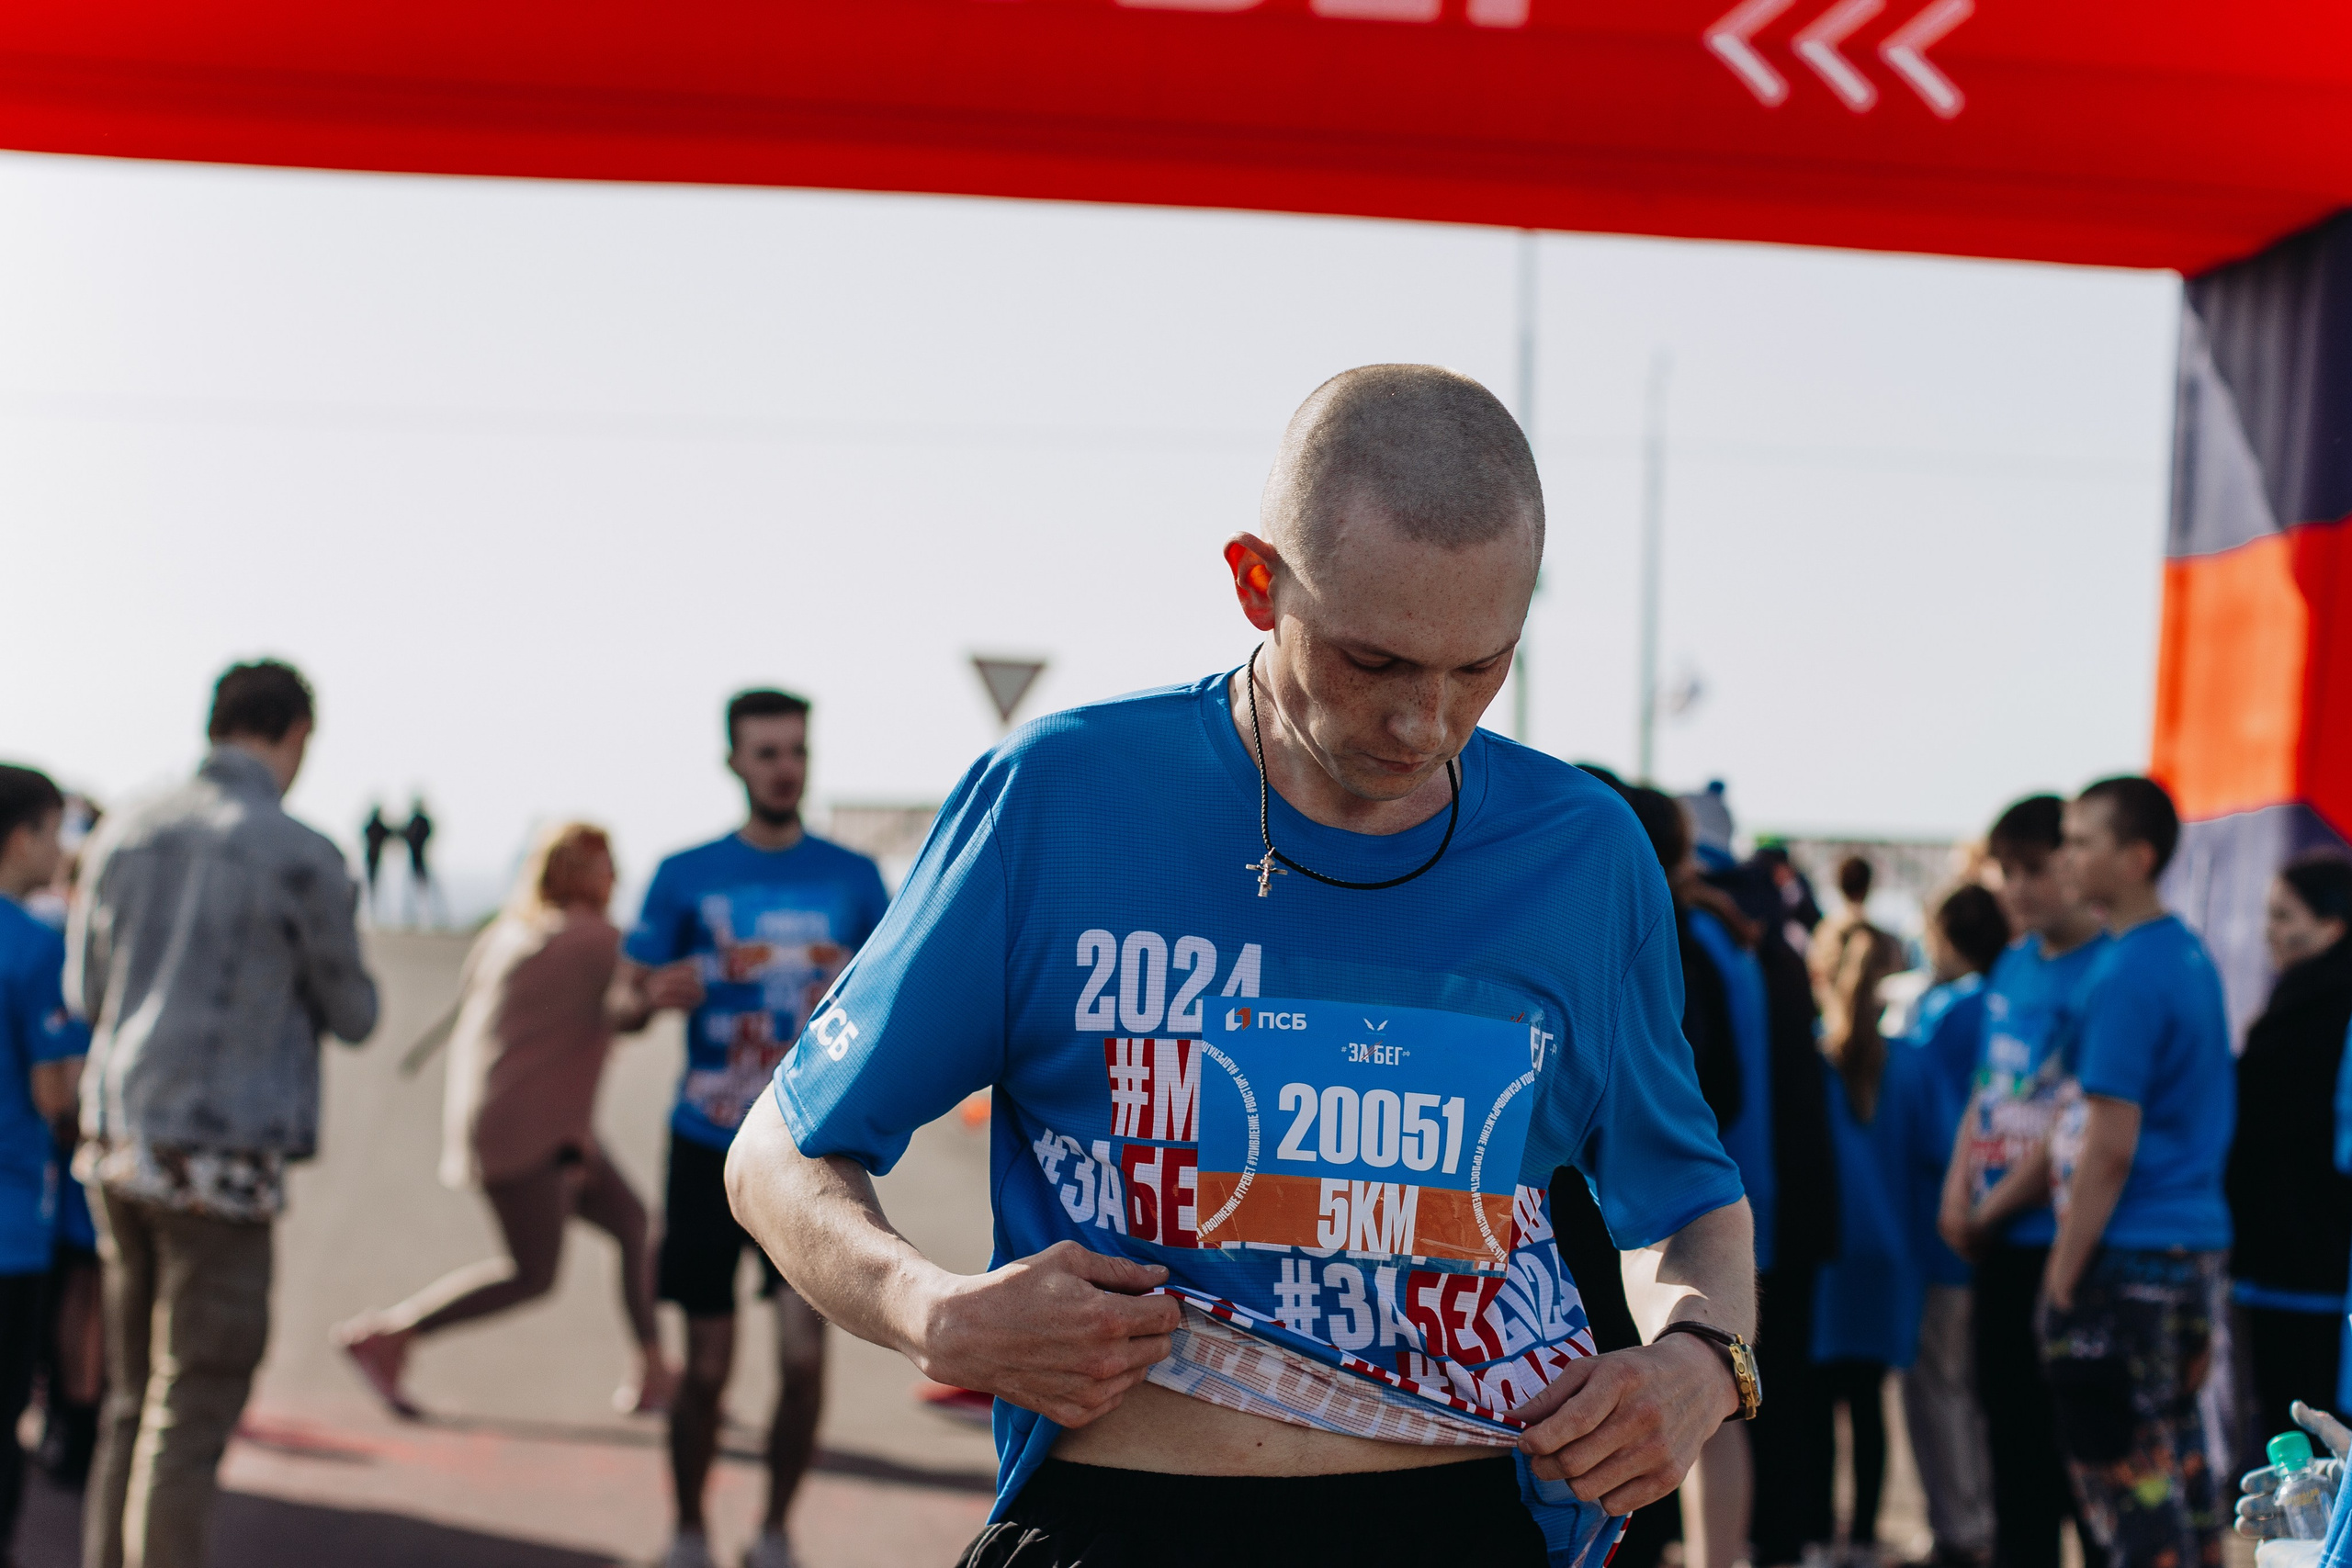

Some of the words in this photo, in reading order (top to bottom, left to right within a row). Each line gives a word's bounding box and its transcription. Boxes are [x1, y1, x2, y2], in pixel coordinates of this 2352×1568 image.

[1258, 1011, 1307, 1031] ПСБ
[1232, 1073, 1258, 1113] #ВОСТОРГ
[1476, 1078, 1522, 1146] #САМОВЫРАЖЕНИЕ
[1246, 1113, 1261, 1167] #УДИВЛЕНИЕ
[1276, 1082, 1465, 1175] 20051
[1033, 1128, 1198, 1247] #ЗАБЕ
[1233, 1165, 1257, 1201] #ТРЕПЕТ
[1470, 1145, 1486, 1192] #ГОРДОСТЬ
[1201, 1195, 1241, 1235] #ВОЛНЕНИЕ
[1471, 1191, 1492, 1237] #ЕДИНСТВО
[1485, 1233, 1508, 1263] #МЕЧТА
